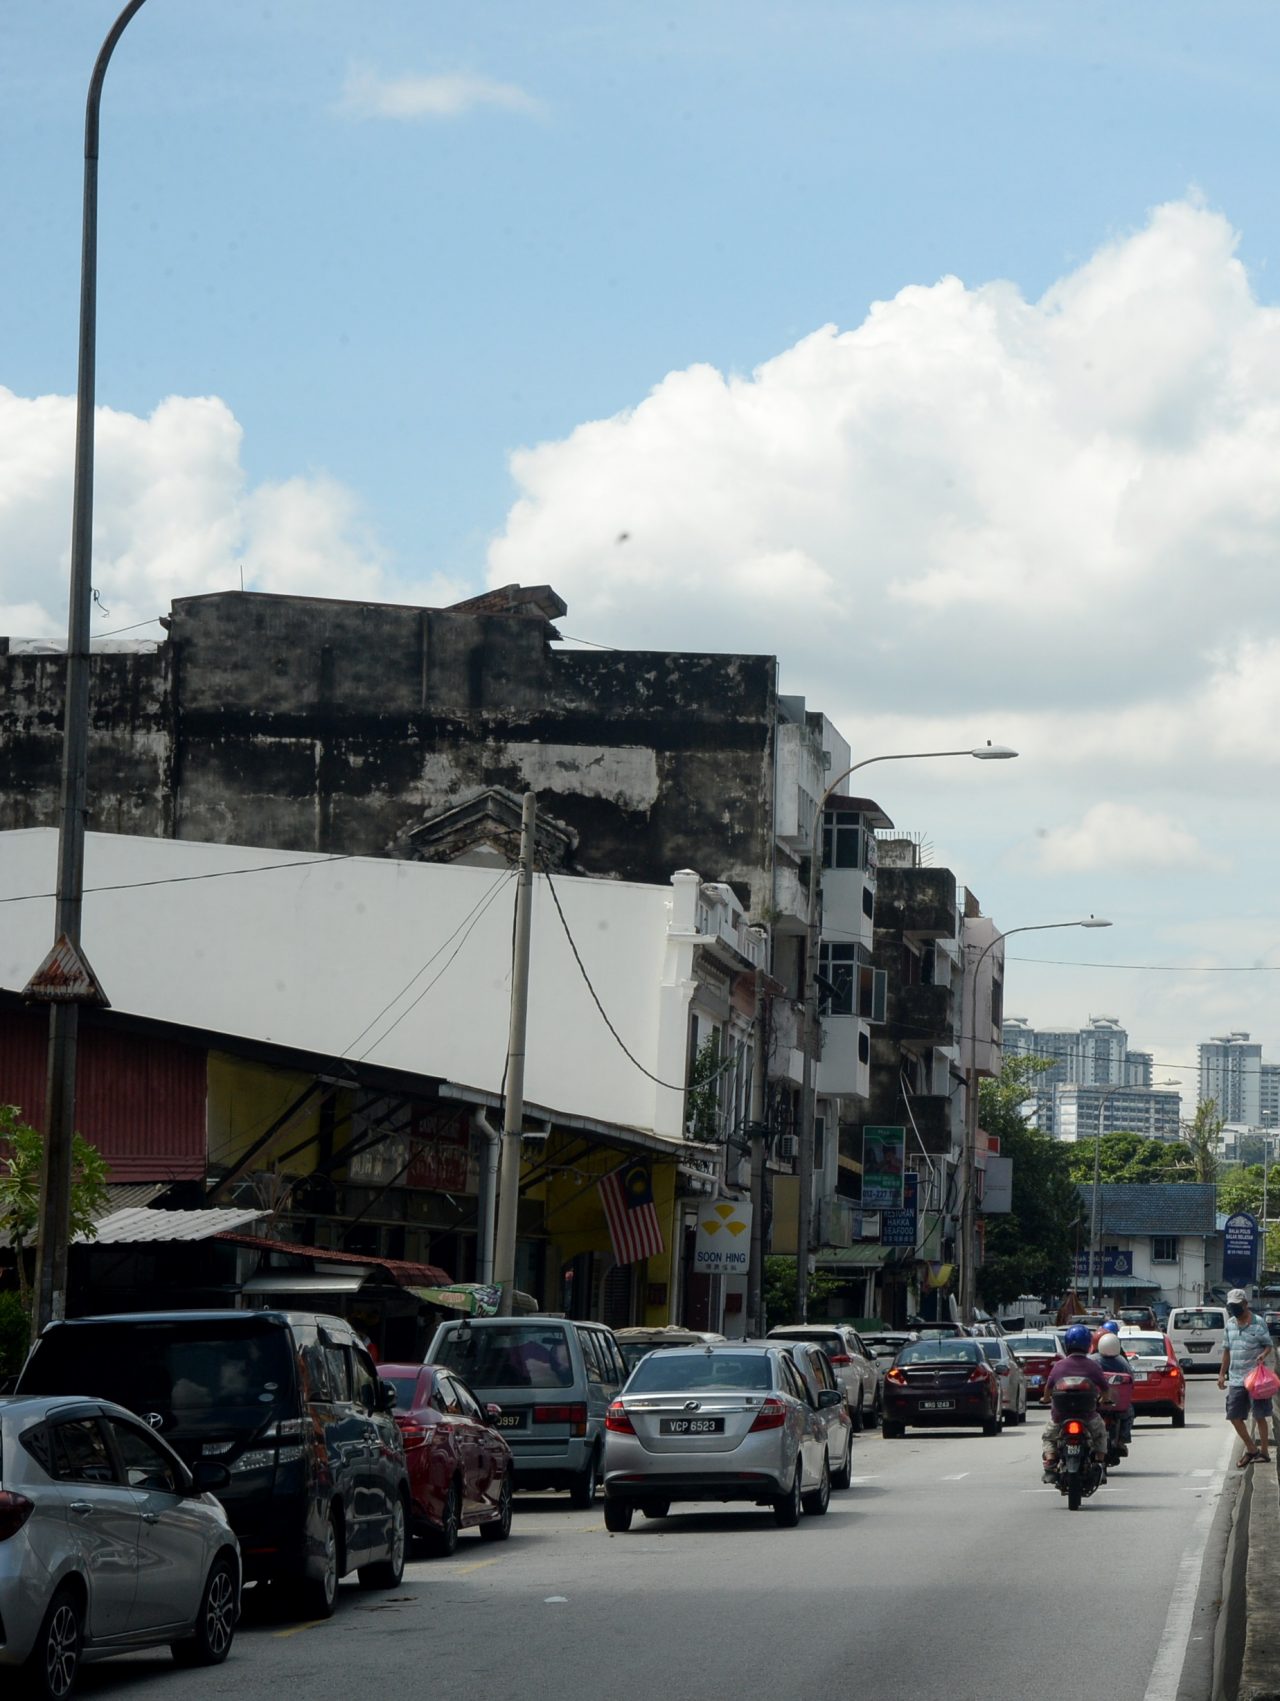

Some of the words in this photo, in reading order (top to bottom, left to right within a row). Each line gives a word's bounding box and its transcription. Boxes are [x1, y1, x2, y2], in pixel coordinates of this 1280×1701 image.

[887, 1218, 910, 1226] HAKKA
[883, 1227, 914, 1235] SEAFOOD
[697, 1252, 722, 1262] SOON
[726, 1252, 747, 1263] HING
[669, 1420, 689, 1432] VCP
[690, 1420, 716, 1432] 6523
